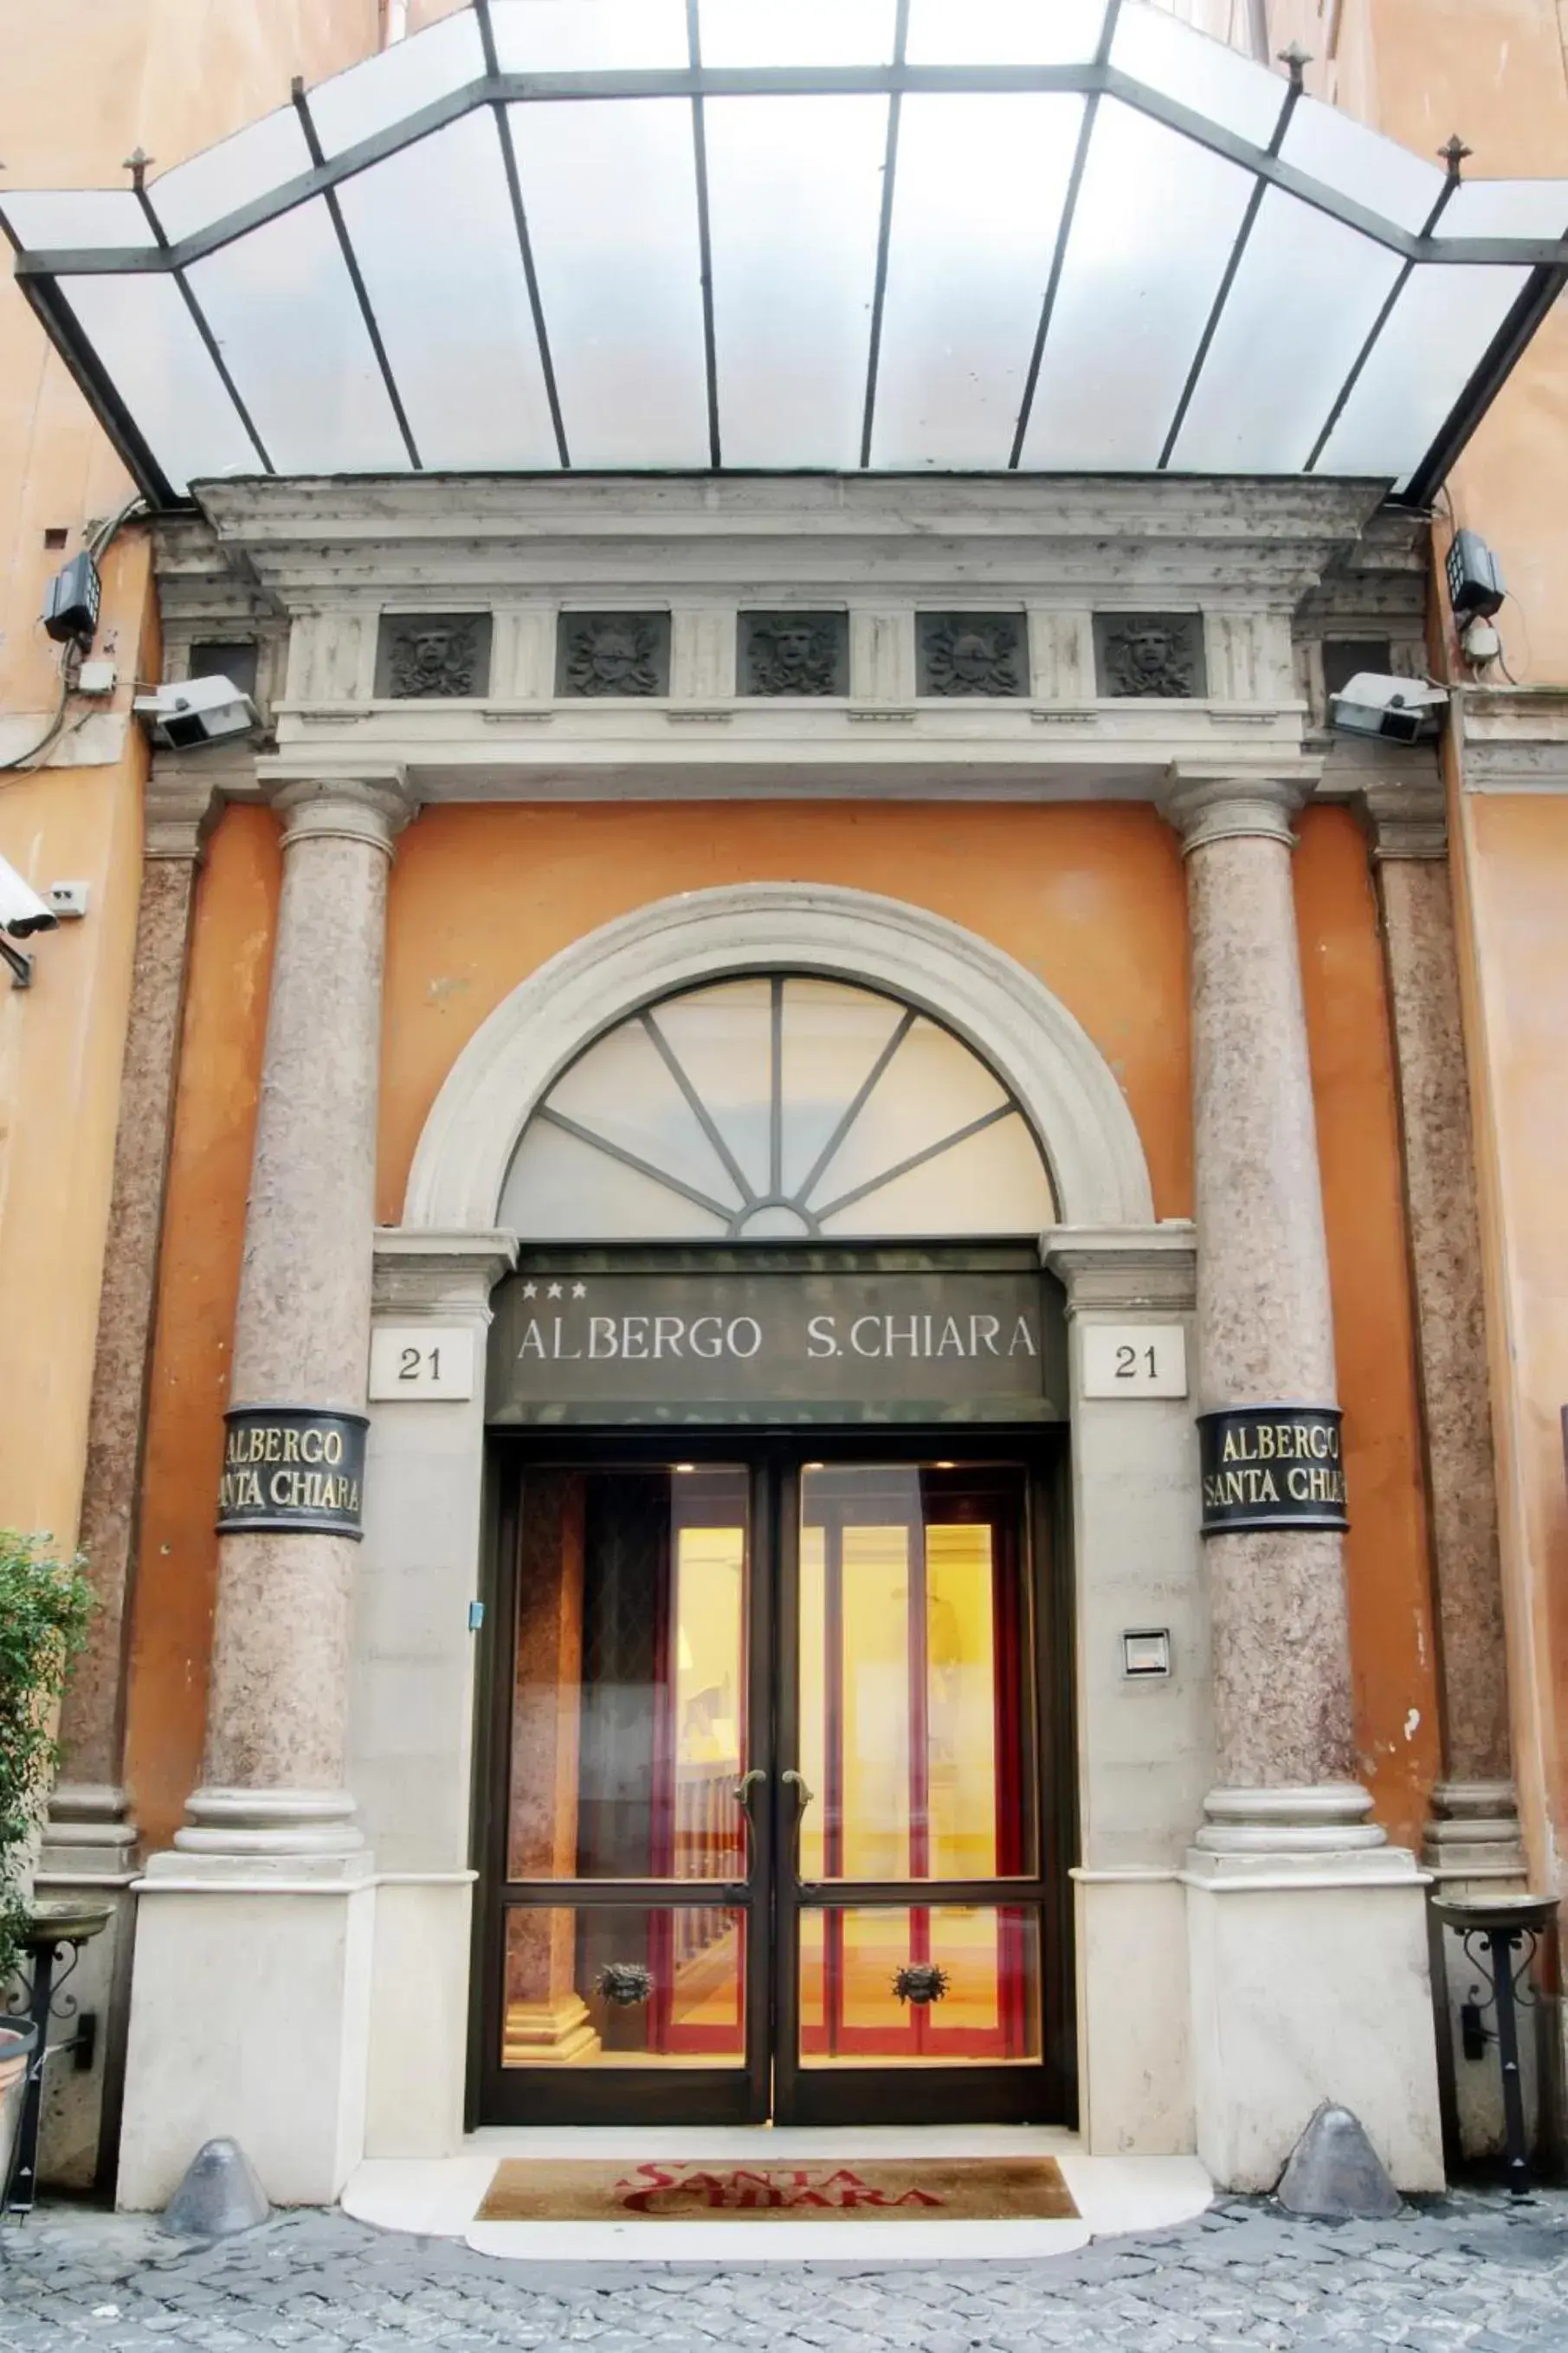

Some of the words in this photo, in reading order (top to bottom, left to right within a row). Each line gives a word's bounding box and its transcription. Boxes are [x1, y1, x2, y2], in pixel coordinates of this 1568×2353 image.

[517, 1315, 763, 1359] ALBERGO
[398, 1347, 440, 1380] 21
[1114, 1345, 1158, 1379] 21
[226, 1428, 343, 1466] ALBERGO
[269, 1470, 360, 1511] CHIARA
[1203, 1469, 1281, 1507] SANTA
[616, 2162, 868, 2188] SANTA
[622, 2187, 945, 2214] CHIARA
